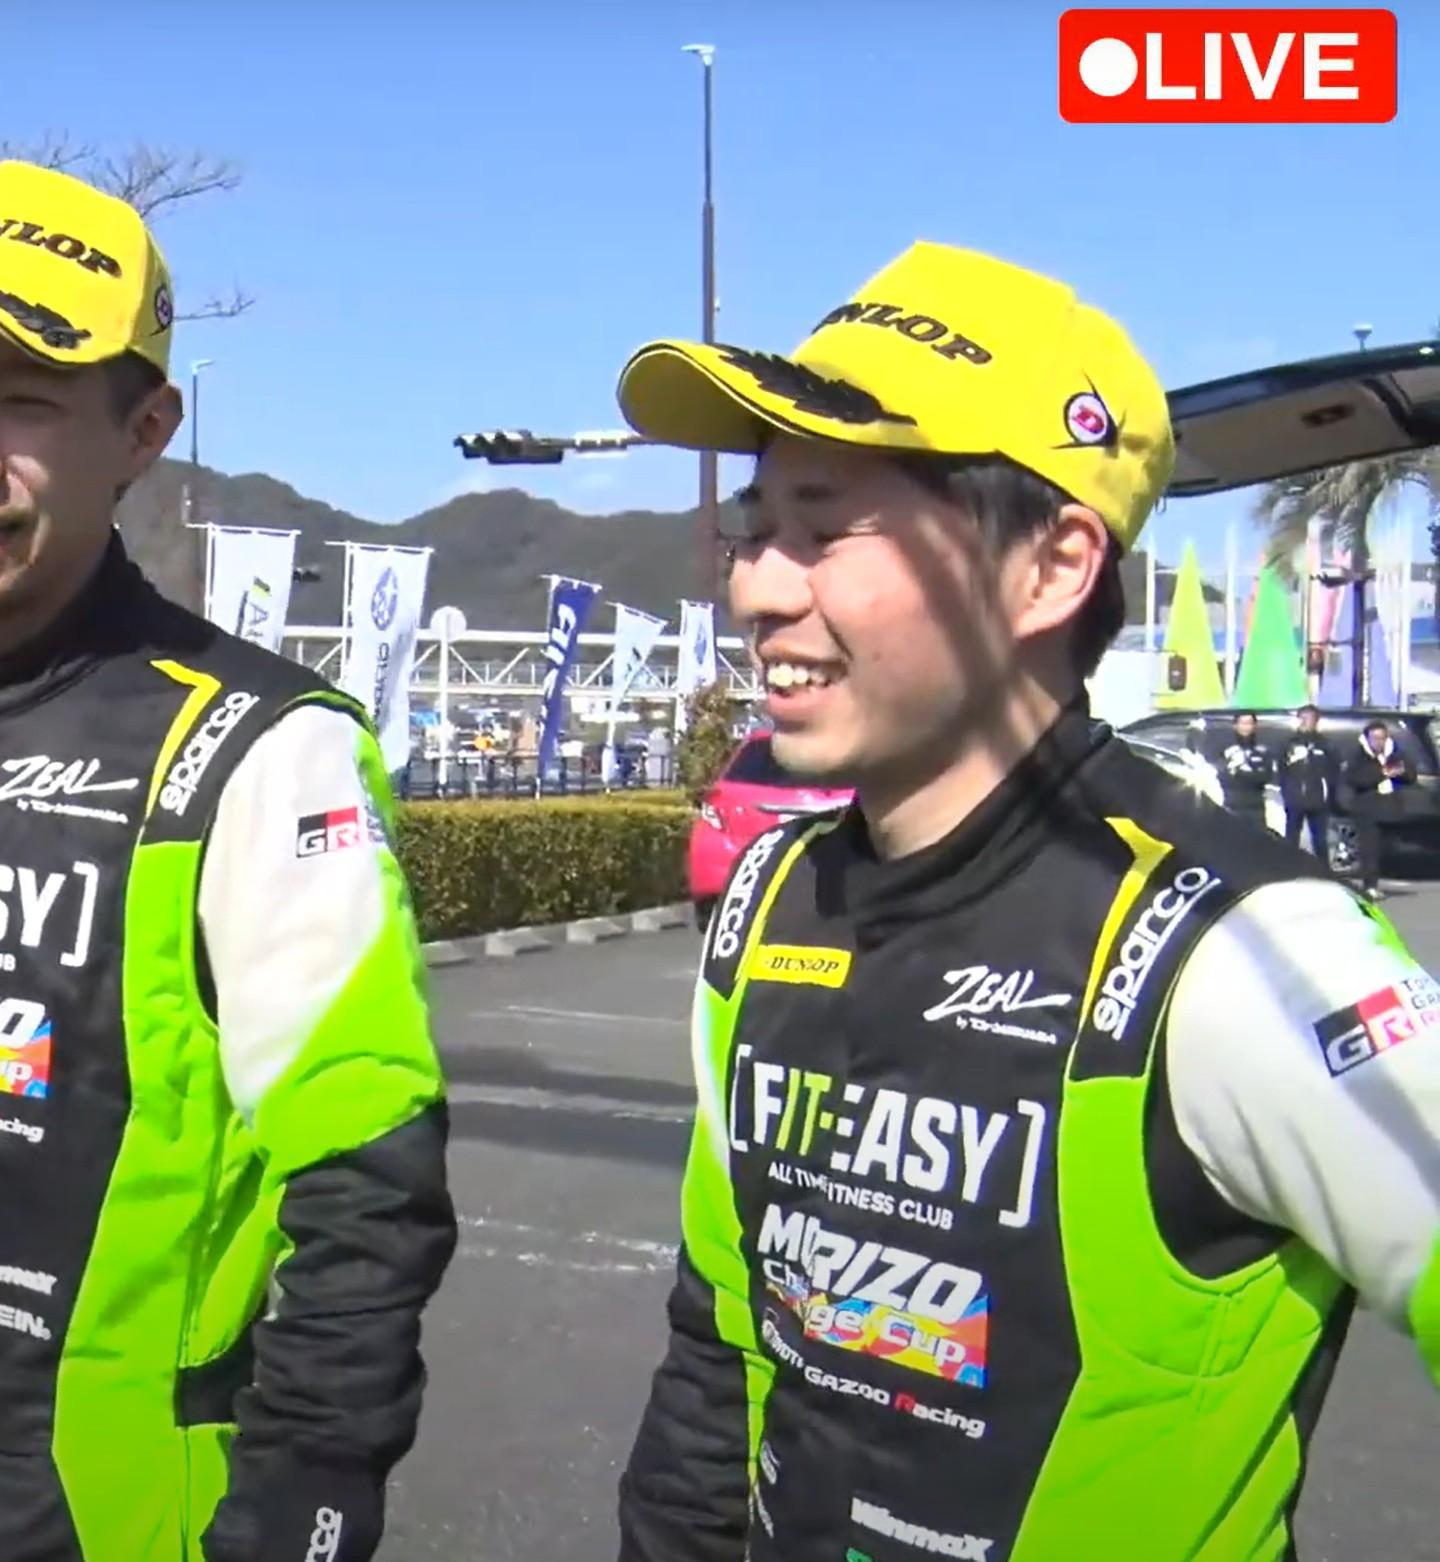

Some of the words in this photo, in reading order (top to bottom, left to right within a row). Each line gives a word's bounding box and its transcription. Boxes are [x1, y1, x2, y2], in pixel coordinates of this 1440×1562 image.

[814, 302, 992, 364] NLOP
[160, 692, 260, 816] sparco
[297, 815, 359, 857] GR
[712, 829, 784, 959] sparco
[1093, 866, 1222, 1041] sparco
[923, 965, 1072, 1020] ZEAL
[1320, 997, 1417, 1074] GR
[768, 1162, 793, 1184] ALL
[899, 1200, 954, 1230] CLUB
[880, 1315, 966, 1367] Cup
[804, 1366, 890, 1404] GAZOO
[895, 1393, 986, 1438] Racing
